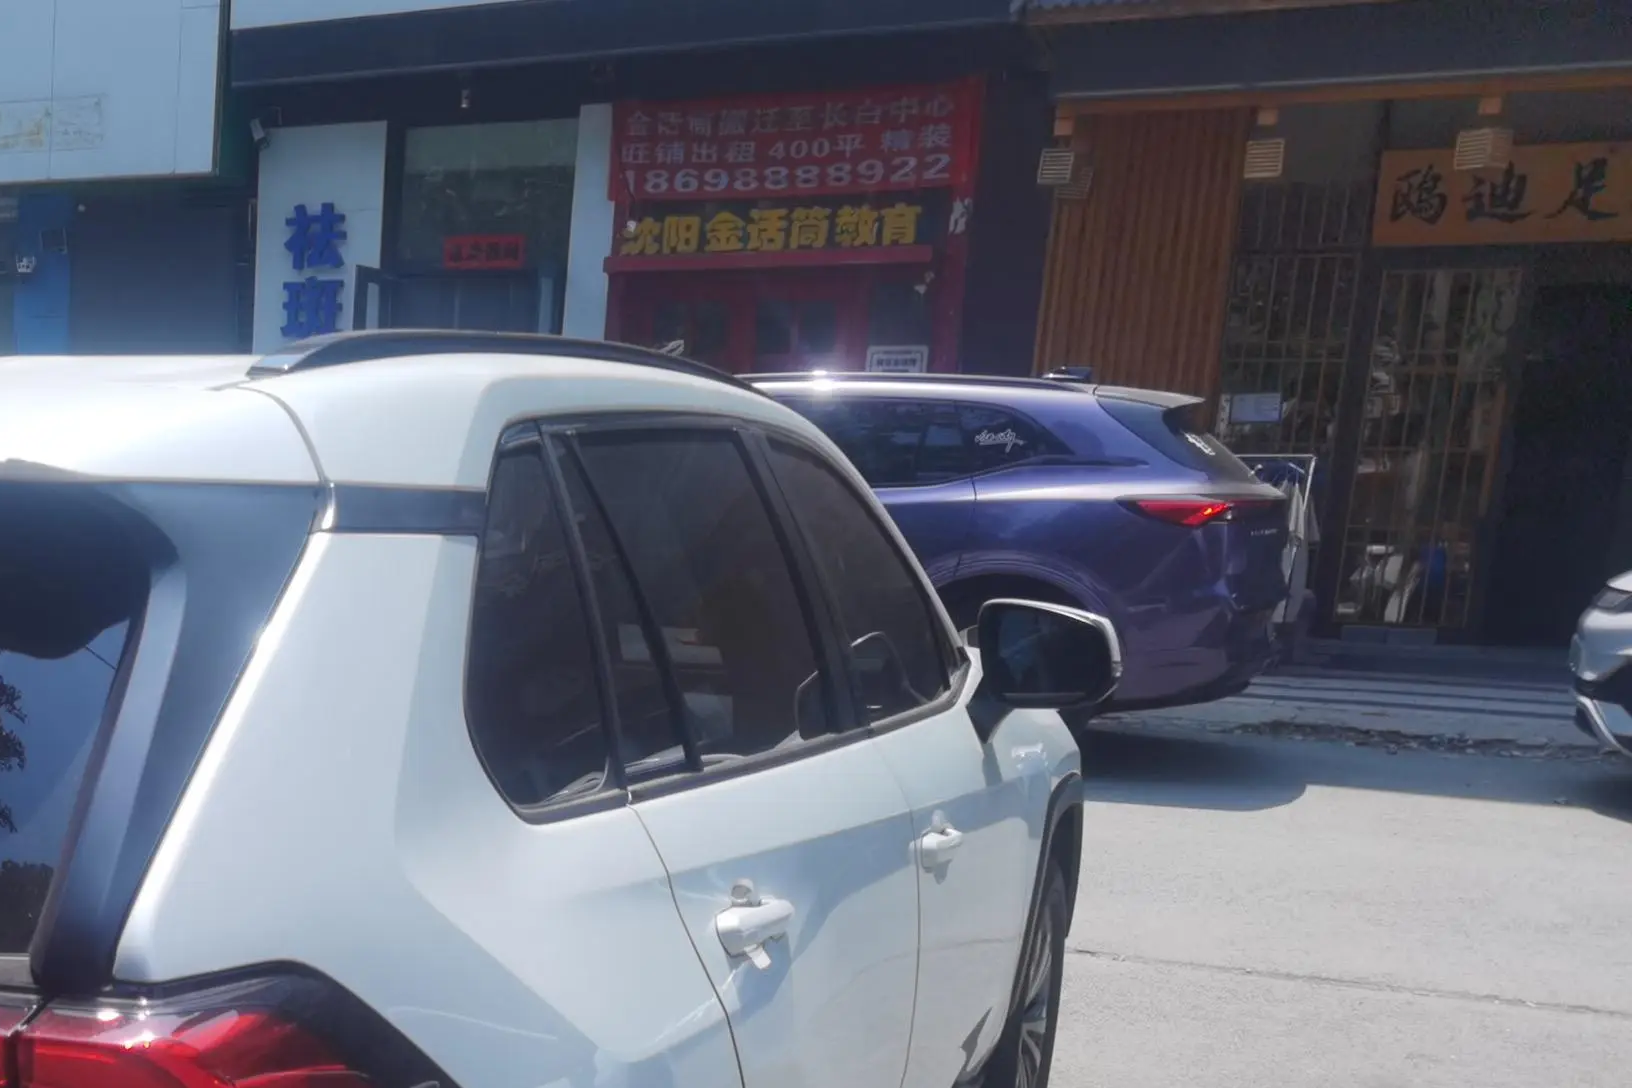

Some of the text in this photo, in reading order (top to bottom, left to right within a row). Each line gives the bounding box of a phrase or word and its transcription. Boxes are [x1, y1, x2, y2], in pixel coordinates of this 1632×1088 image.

[620, 153, 952, 195] 18698888922
[620, 202, 923, 257] 沈阳金话筒教育
